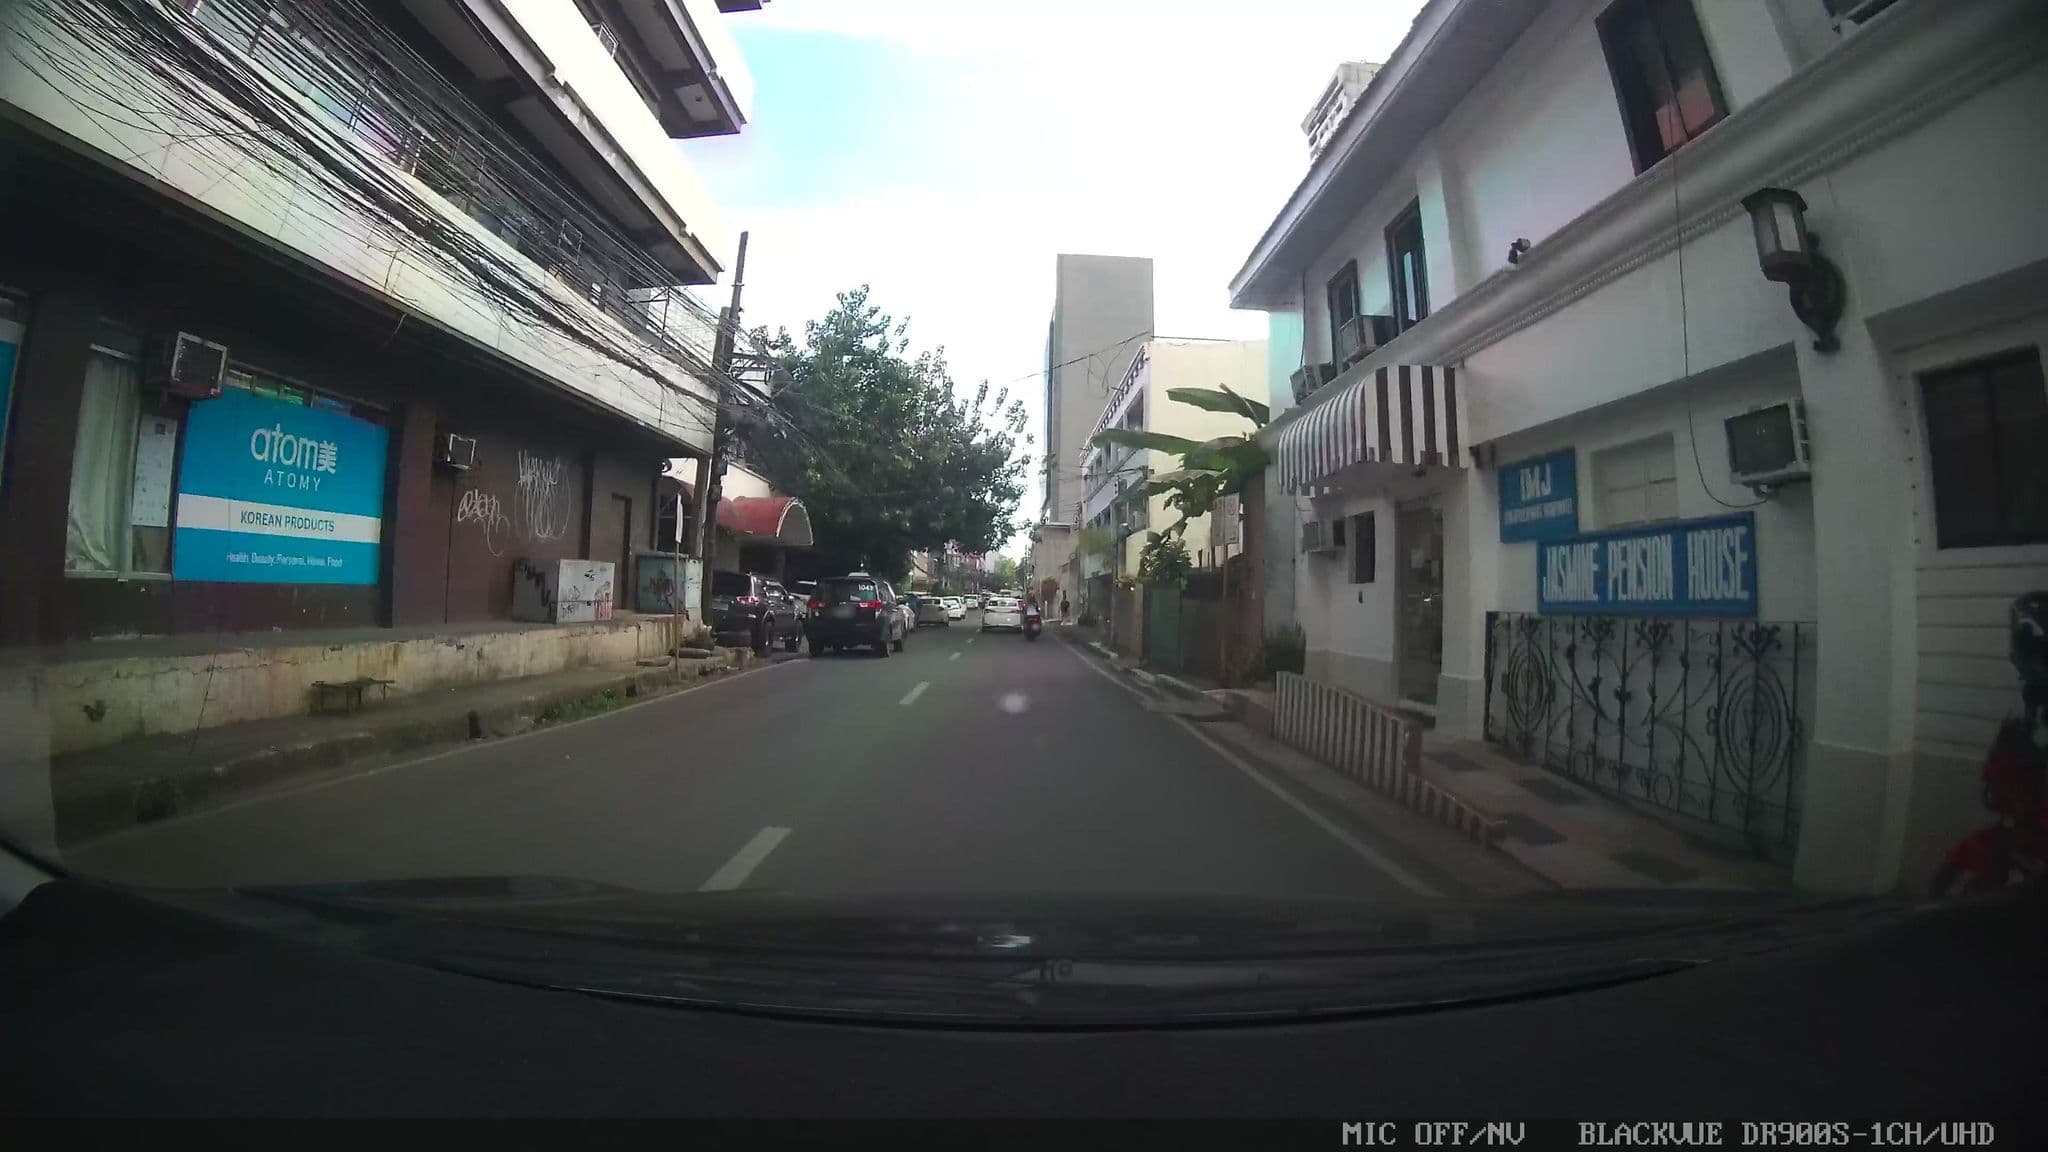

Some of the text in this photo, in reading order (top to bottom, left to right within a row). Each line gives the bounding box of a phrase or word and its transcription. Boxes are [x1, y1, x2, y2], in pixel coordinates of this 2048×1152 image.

[264, 468, 321, 493] ATOMY
[240, 510, 336, 533] KOREAN PRODUCTS
[1543, 525, 1750, 602] JASMINE PENSION HOUSE
